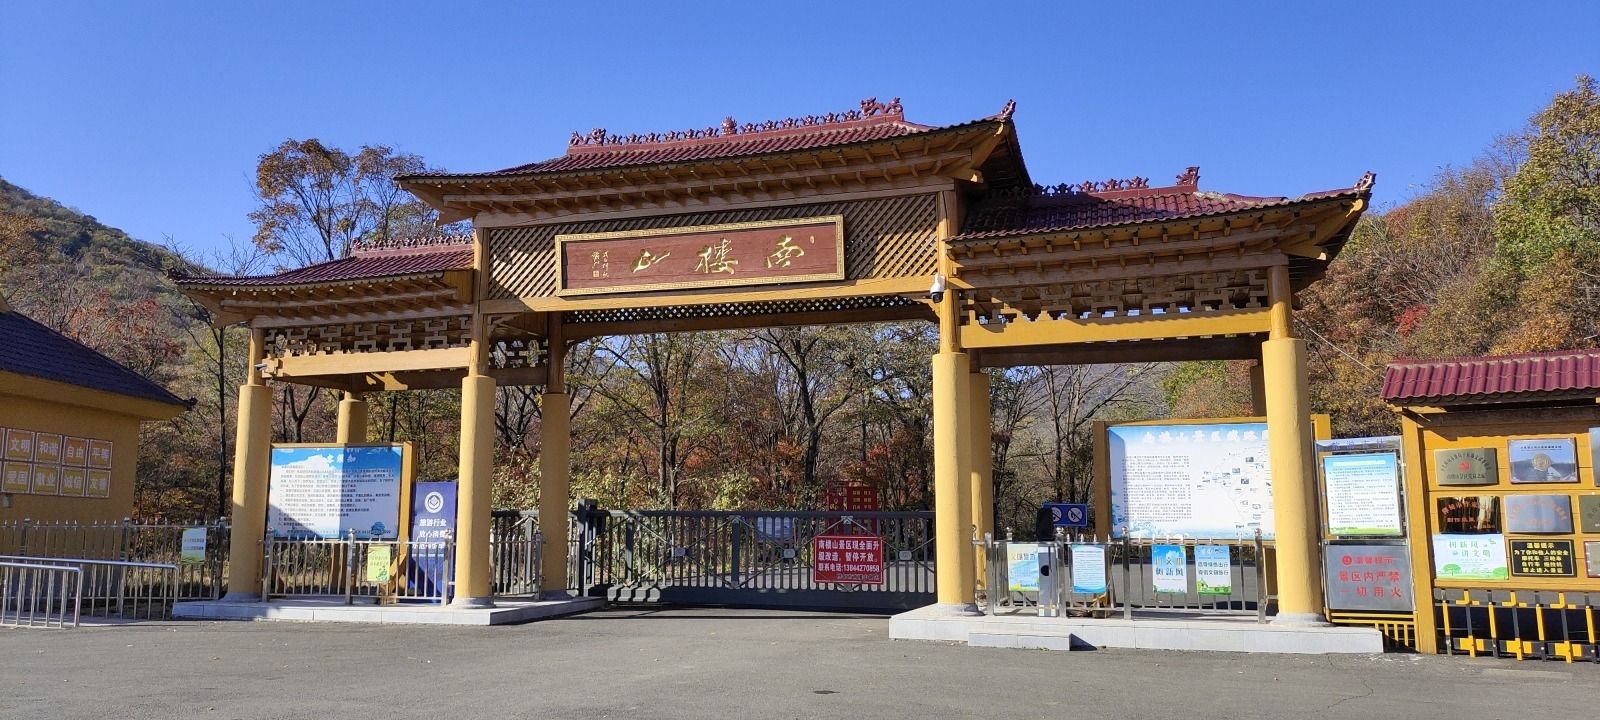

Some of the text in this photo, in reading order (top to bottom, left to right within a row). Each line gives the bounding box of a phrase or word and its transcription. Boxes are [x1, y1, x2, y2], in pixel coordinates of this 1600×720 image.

[11, 438, 110, 460] 文明 和谐 自由 平等
[36, 472, 56, 487] 敬业
[64, 475, 82, 488] 诚信
[419, 518, 447, 527] 旅游行业
[1449, 540, 1479, 549] 树新风
[1461, 549, 1491, 558] 讲文明
[1356, 555, 1394, 565] 温馨提示
[1155, 567, 1184, 576] 树新风
[1339, 570, 1401, 583] 景区内严禁
[1339, 585, 1402, 598] 一切用火
